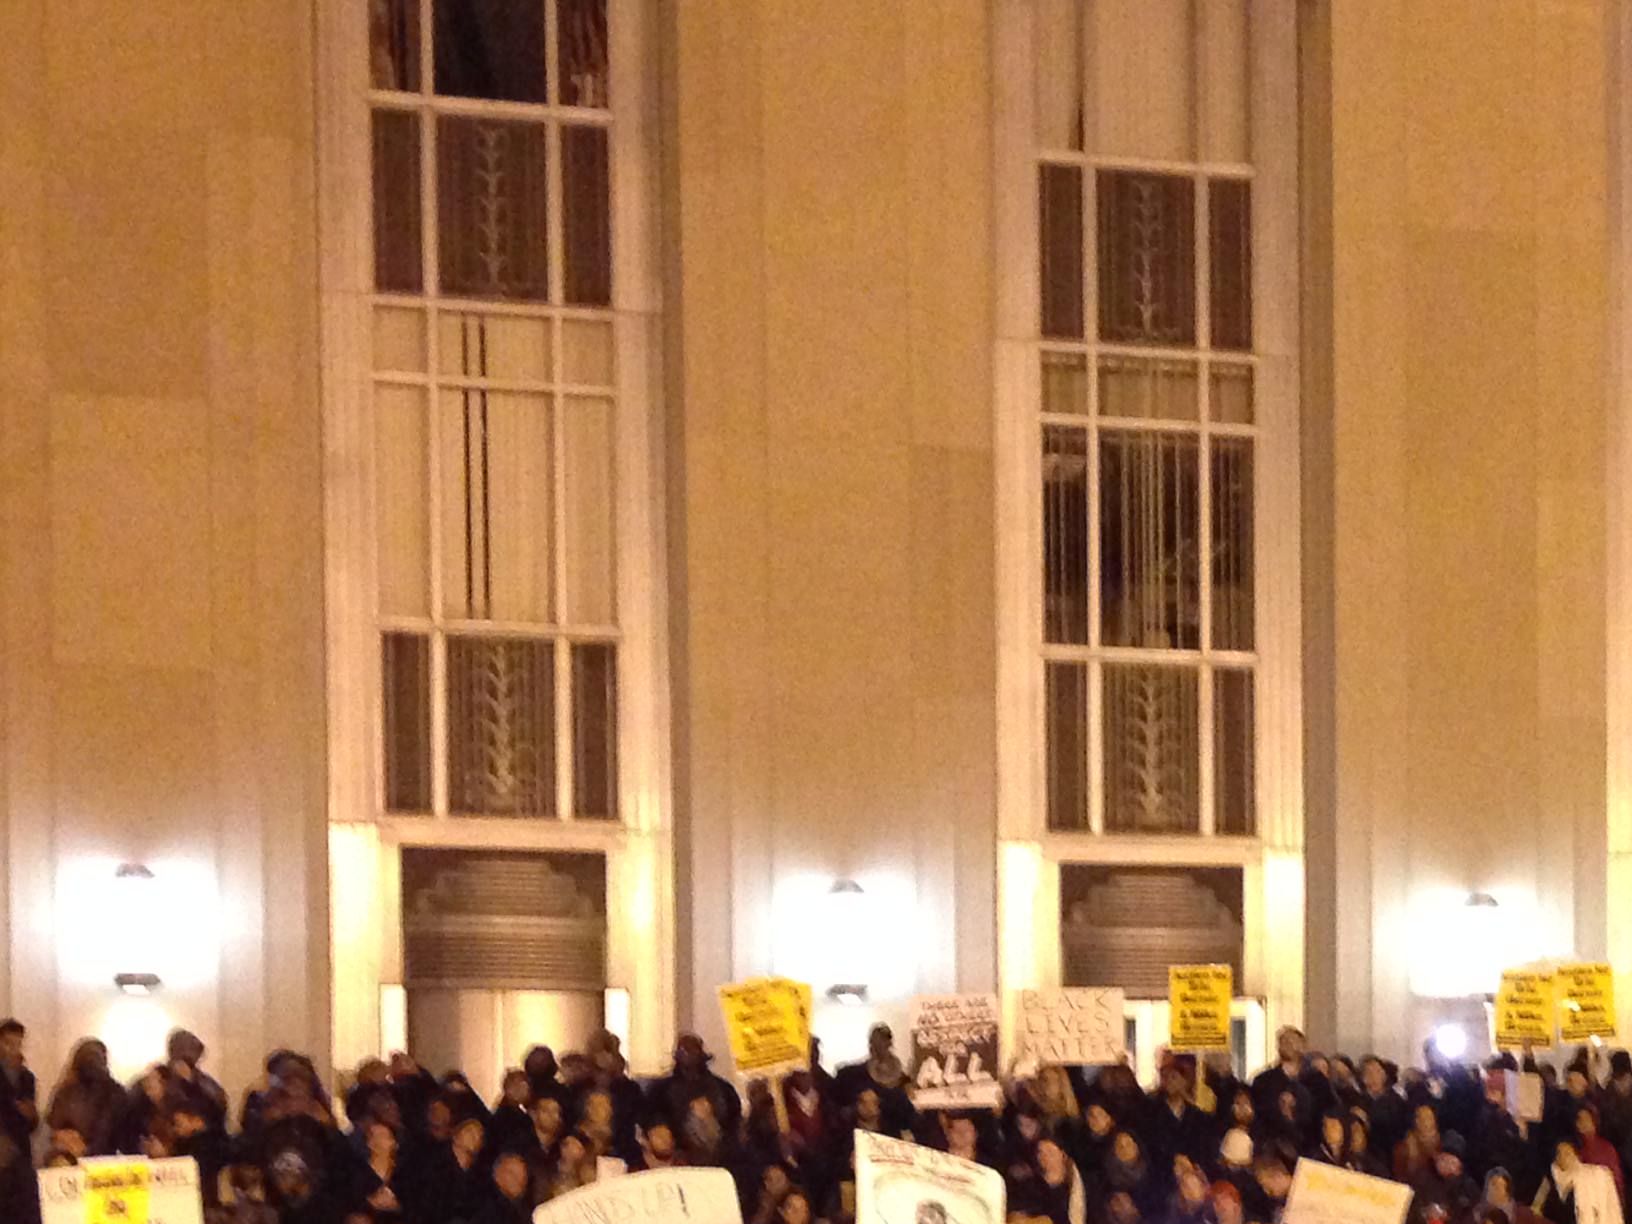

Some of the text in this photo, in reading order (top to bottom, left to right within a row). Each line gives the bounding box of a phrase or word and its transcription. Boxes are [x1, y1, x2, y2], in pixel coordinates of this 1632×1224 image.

[1023, 988, 1112, 1011] BLACK
[1025, 1012, 1110, 1034] LIVES
[1022, 1036, 1120, 1060] MATTER
[916, 1052, 996, 1088] ALL
